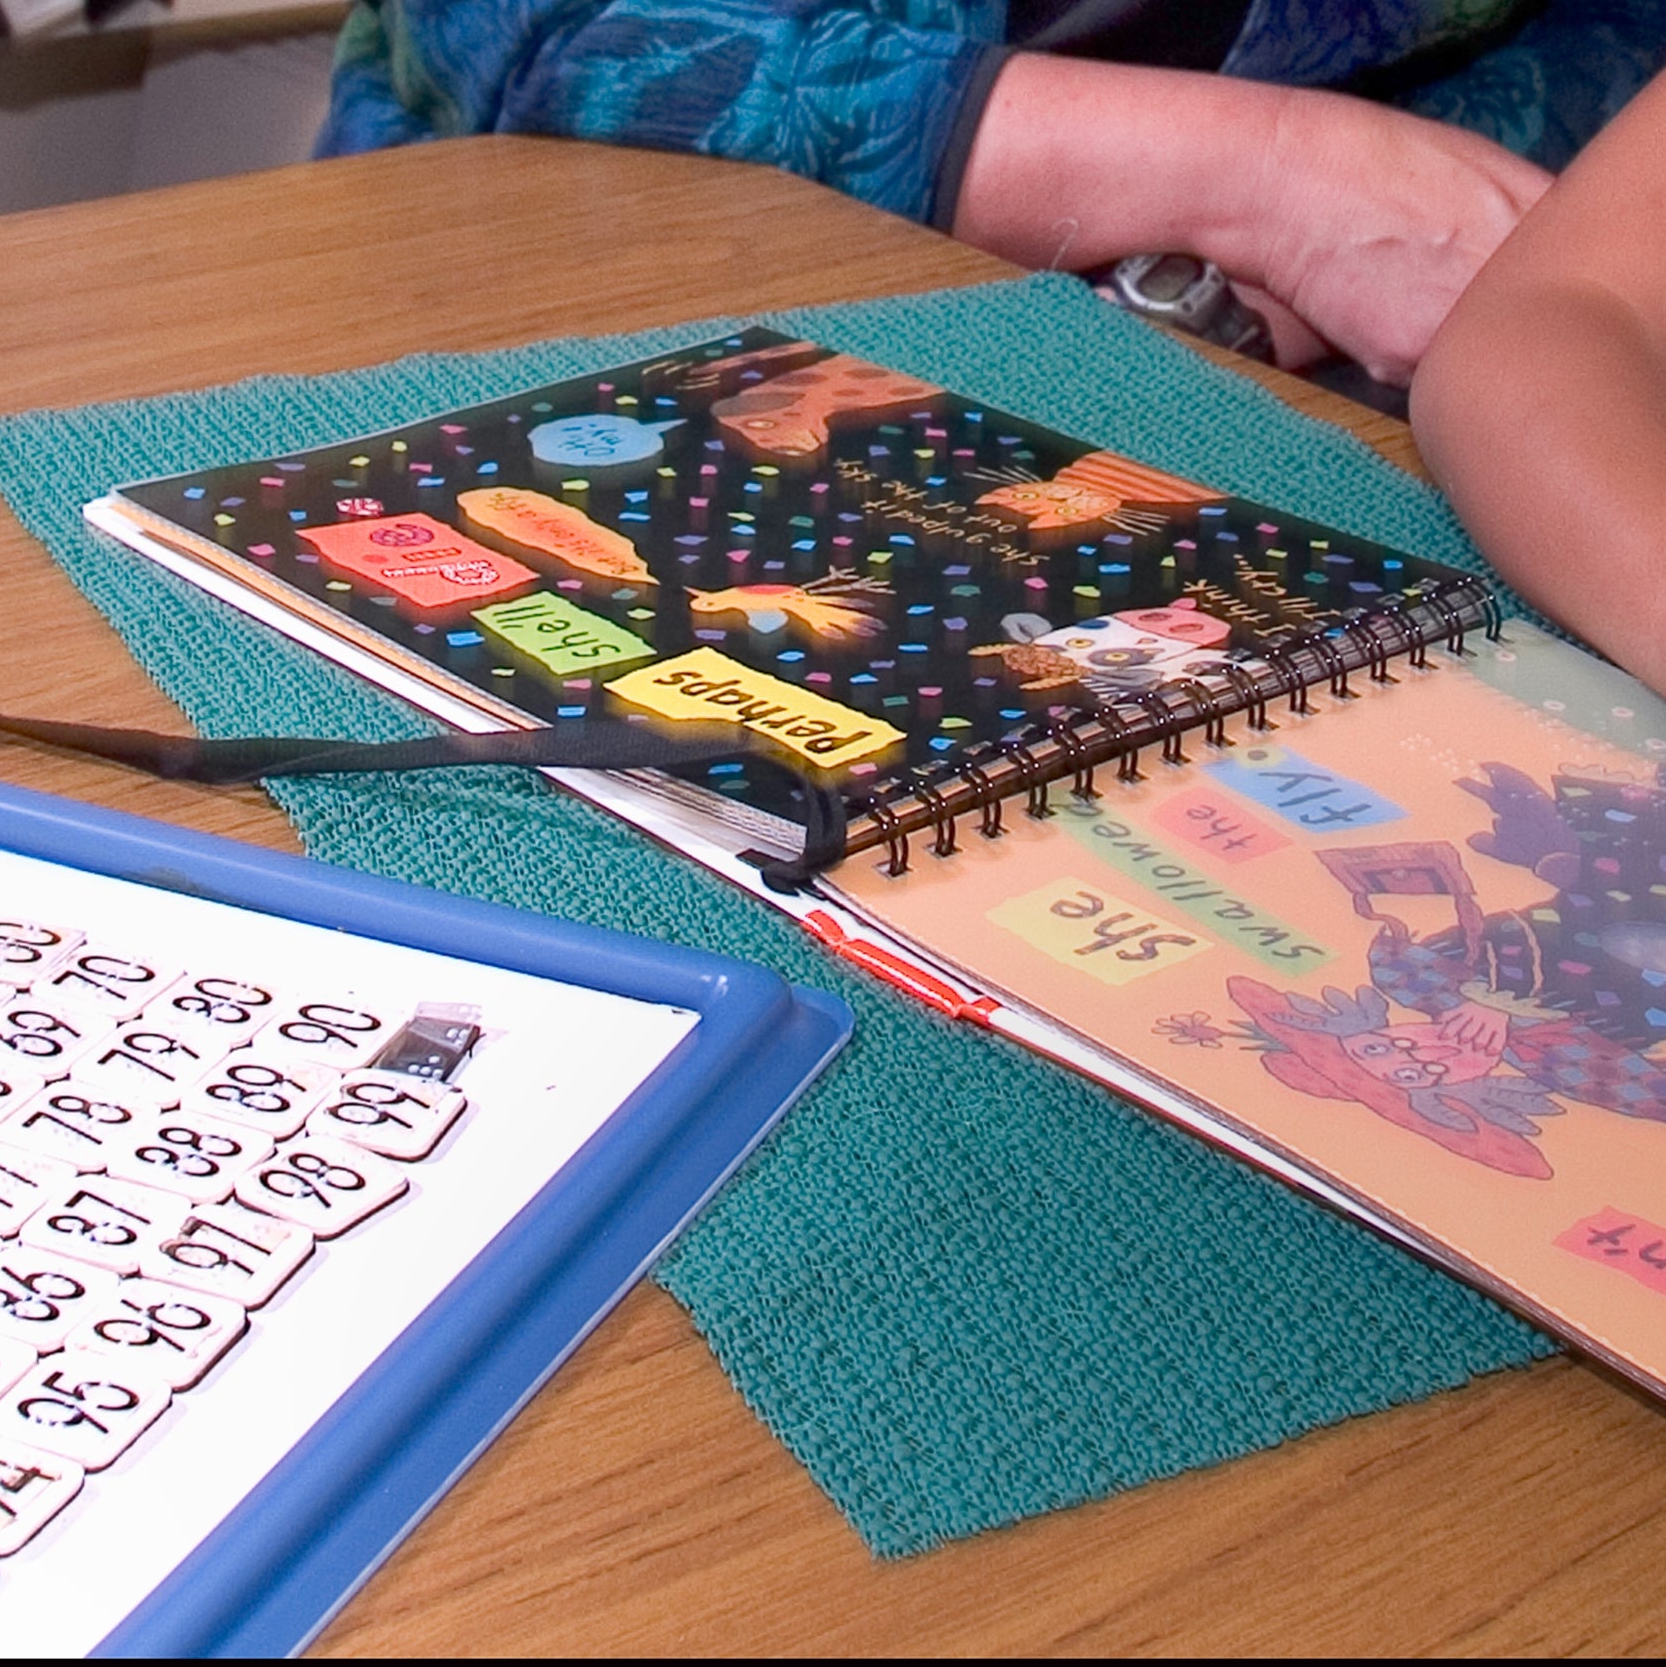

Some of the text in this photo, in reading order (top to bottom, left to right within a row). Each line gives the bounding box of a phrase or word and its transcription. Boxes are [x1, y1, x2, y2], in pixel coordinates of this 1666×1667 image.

[882, 478, 928, 499] the
[922, 502, 967, 514] of
[882, 507, 991, 545] gulped
[964, 513, 1017, 534] out
[1181, 578, 1271, 624] think
[1257, 769, 1373, 831] fly
[1185, 803, 1254, 854] the
[52, 955, 156, 999] 70
[21, 1095, 133, 1145] 78
[97, 1032, 200, 1082] 79
[171, 978, 273, 1024] 80
[47, 1190, 151, 1246] 87
[134, 1126, 243, 1178] 88
[205, 1064, 307, 1113] 89
[278, 1004, 382, 1049] 90
[16, 1370, 140, 1435] 95
[94, 1300, 212, 1353] 96
[167, 1219, 272, 1276] 97
[259, 1152, 367, 1209] 98
[329, 1082, 431, 1130] 99
